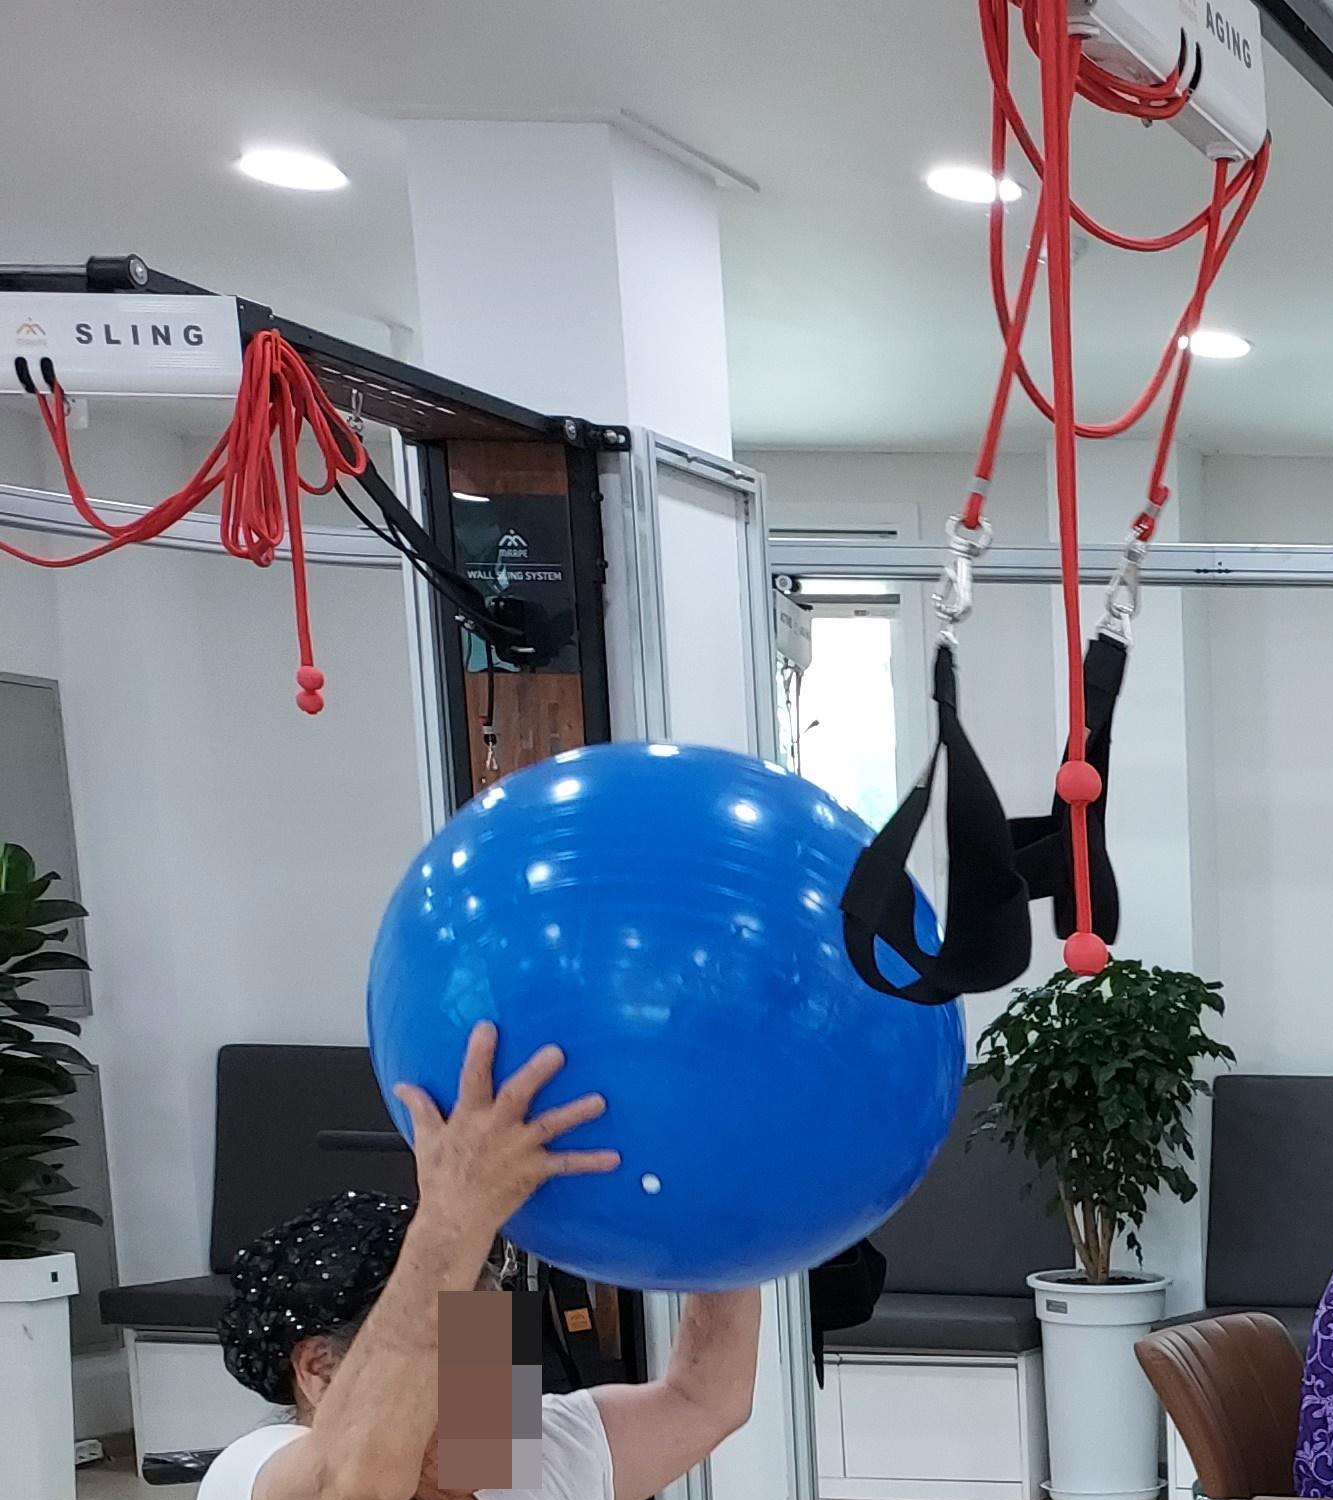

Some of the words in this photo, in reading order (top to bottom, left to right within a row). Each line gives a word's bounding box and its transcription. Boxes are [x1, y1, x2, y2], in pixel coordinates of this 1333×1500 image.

[1205, 2, 1252, 69] AGING
[75, 323, 204, 346] SLING
[525, 571, 562, 581] SYSTEM
